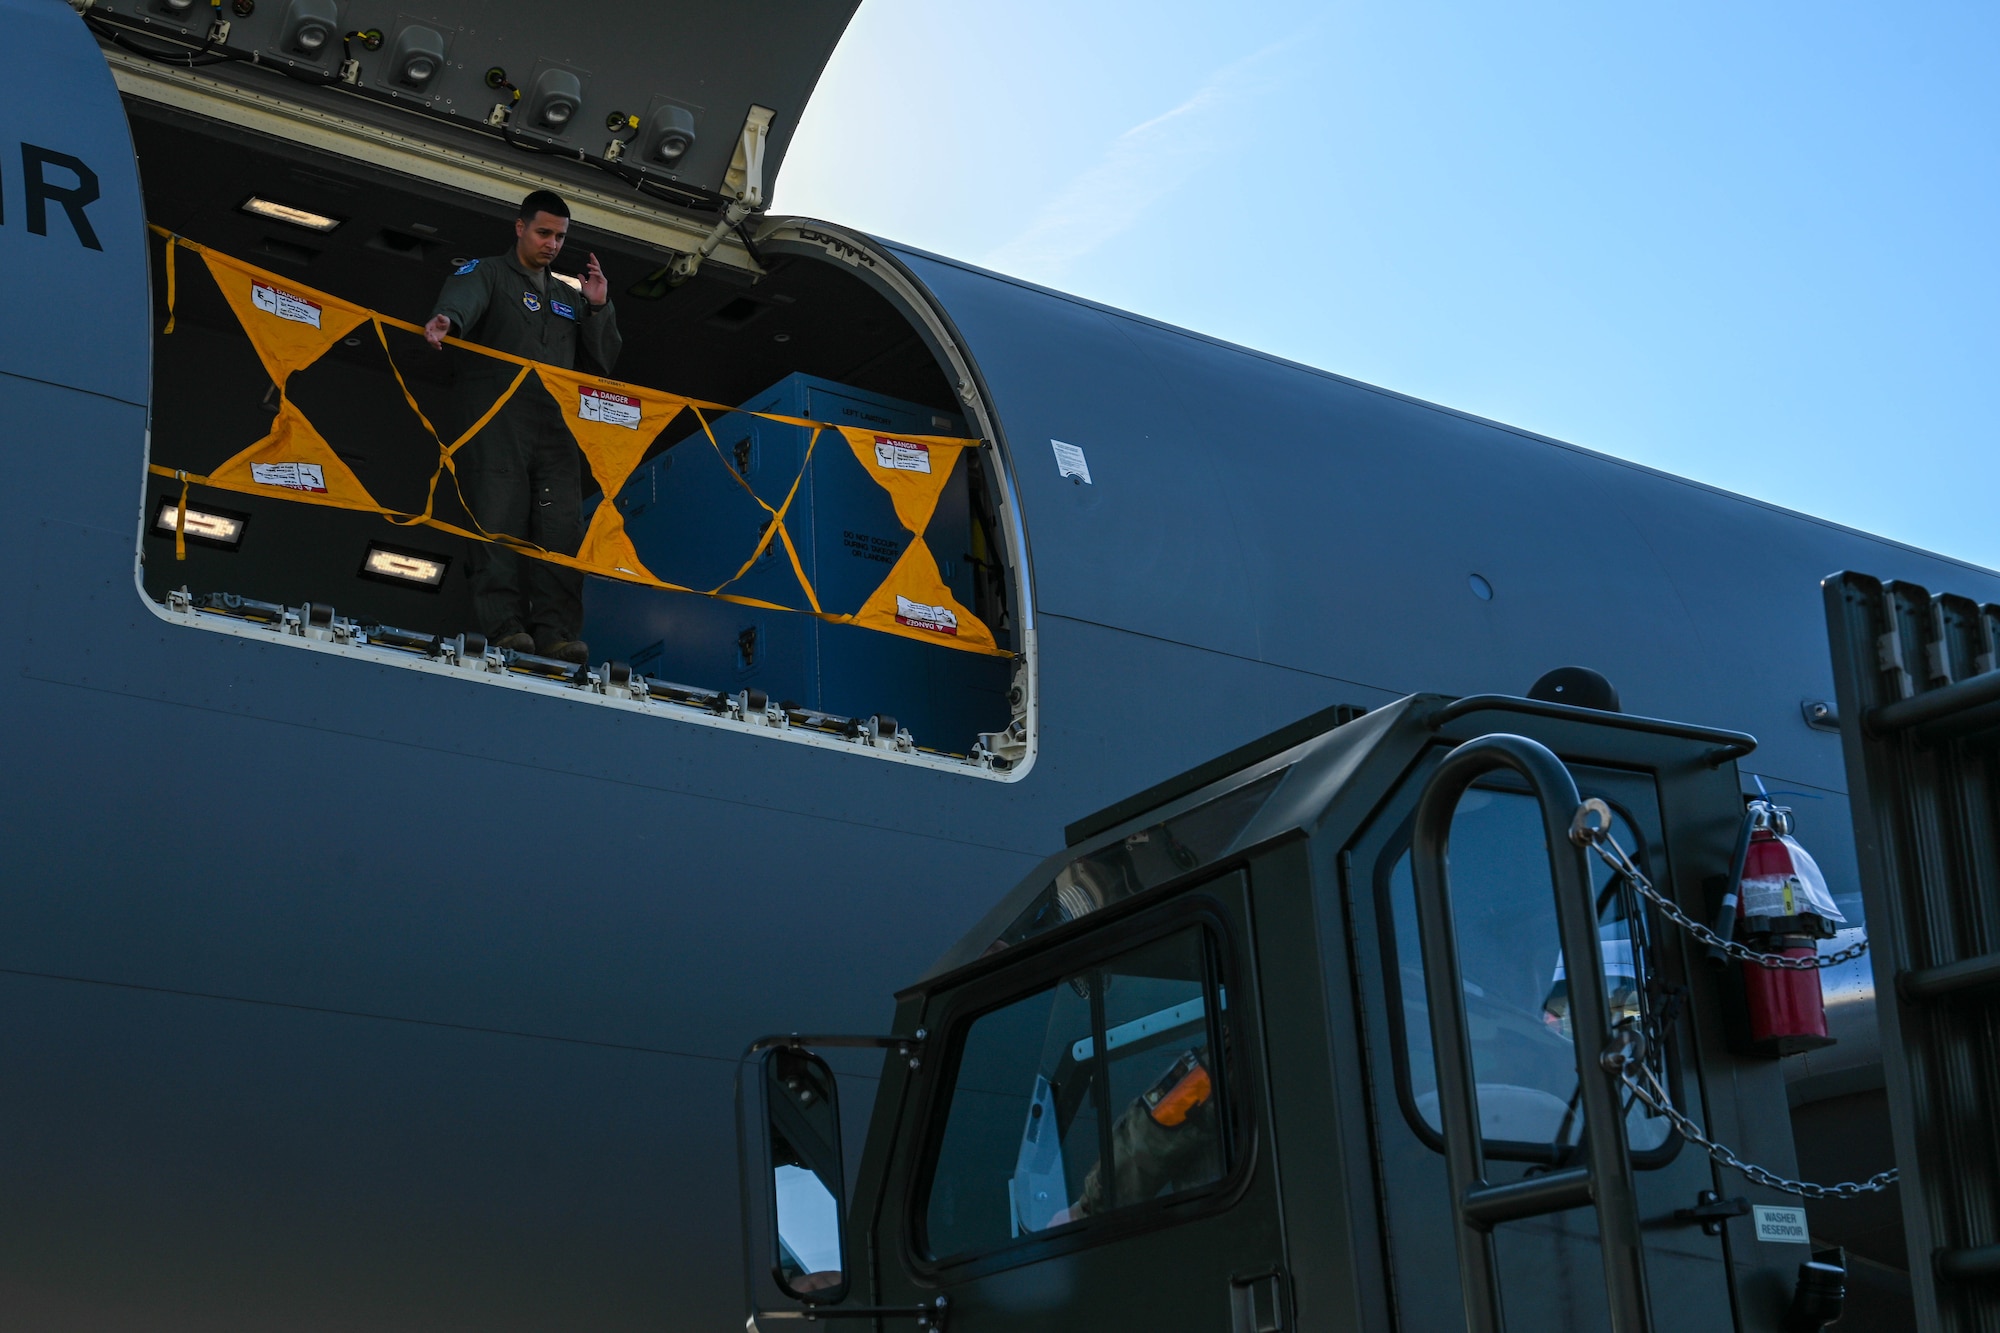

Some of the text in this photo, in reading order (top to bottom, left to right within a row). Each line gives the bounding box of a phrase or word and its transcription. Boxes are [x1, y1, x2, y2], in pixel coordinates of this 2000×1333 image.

[0, 141, 104, 252] R
[600, 391, 629, 404] DANGER
[893, 441, 918, 450] DANGER
[843, 530, 899, 549] DO NOT OCCUPY
[843, 539, 899, 557] DURING TAKEOFF
[852, 549, 893, 564] OR LANDING
[906, 618, 935, 629] DANGER
[1763, 1212, 1797, 1224] WASHER
[1761, 1224, 1803, 1236] RESERVOIR
